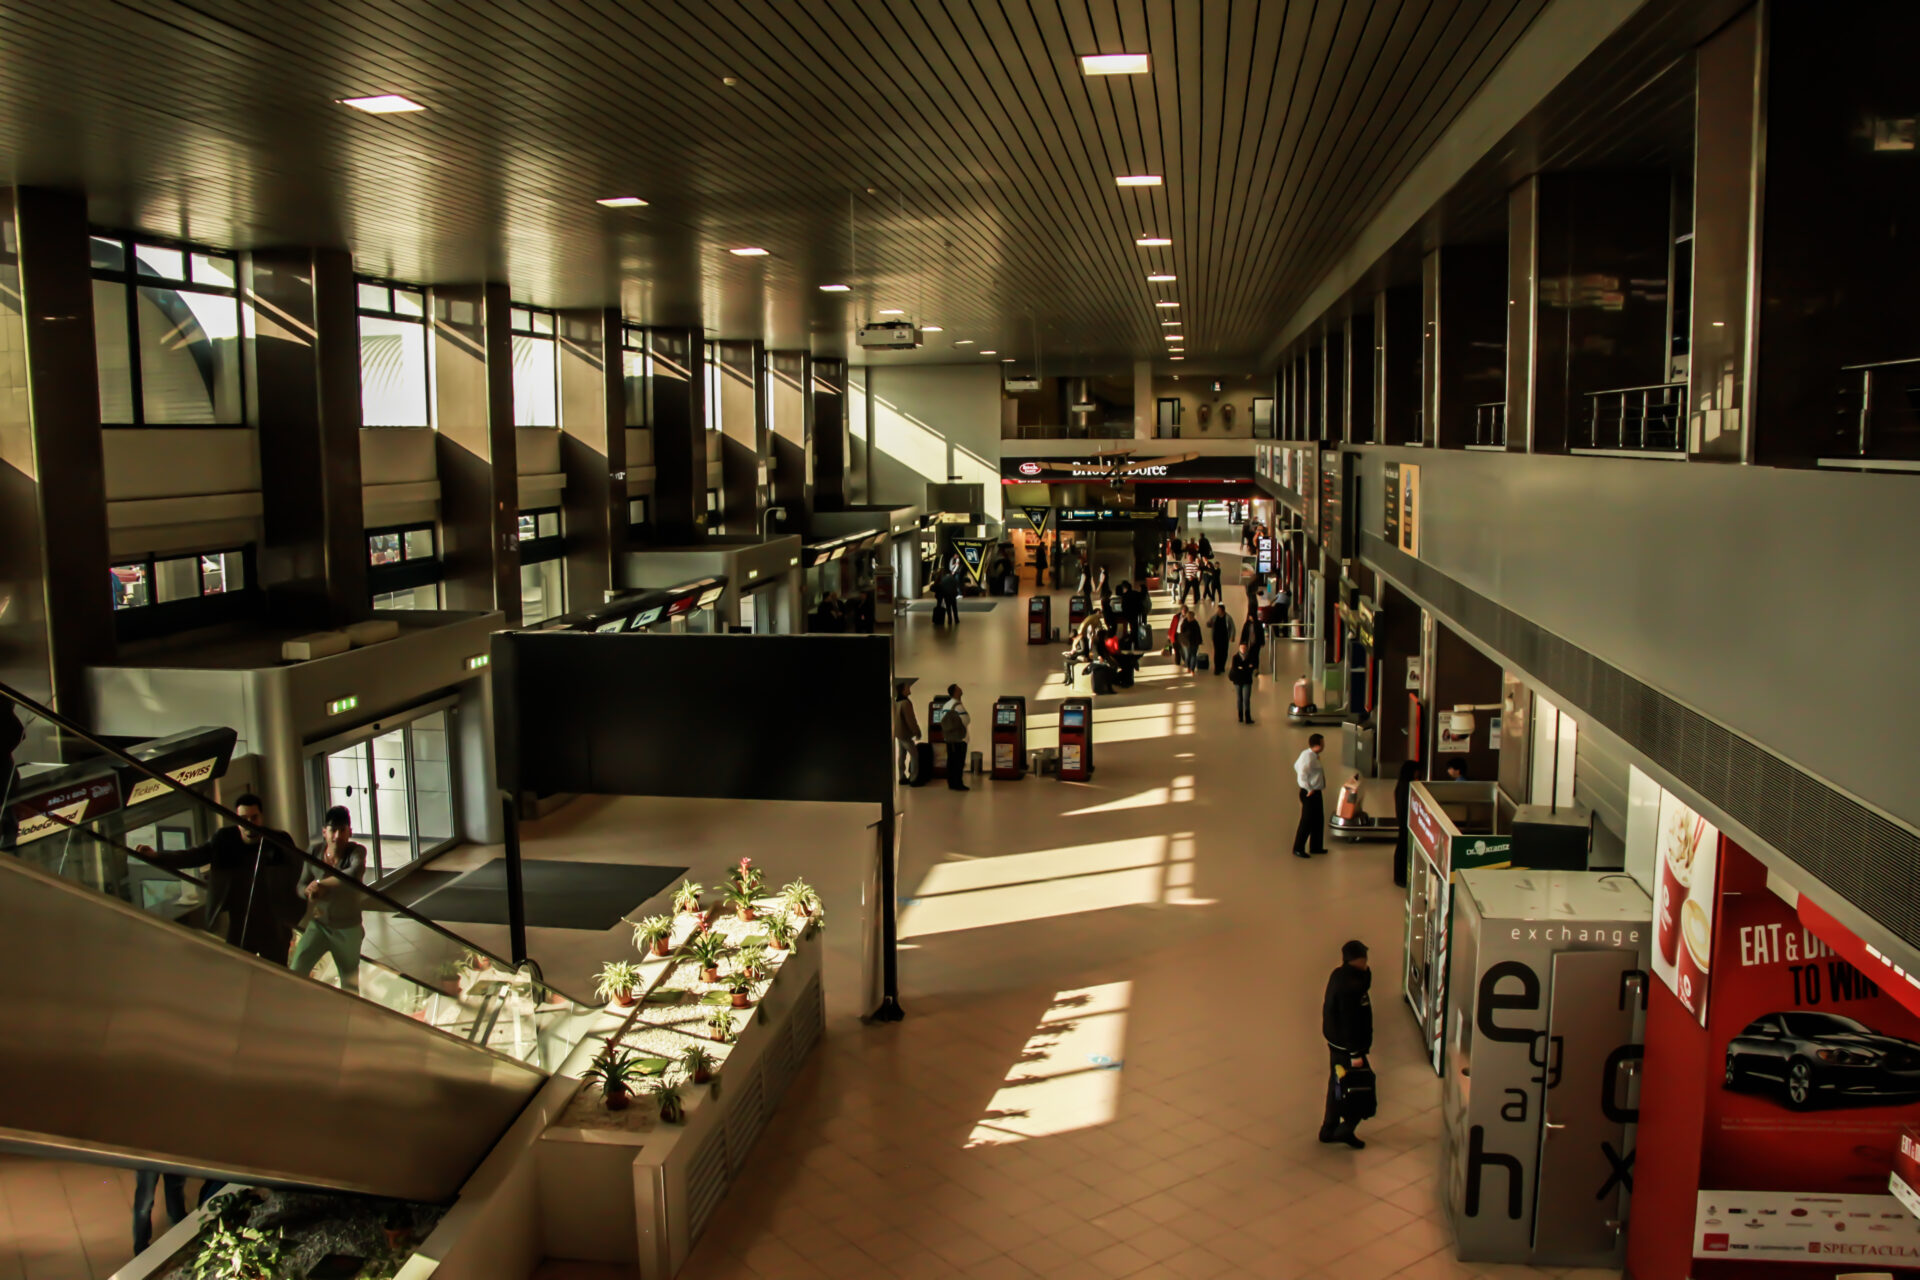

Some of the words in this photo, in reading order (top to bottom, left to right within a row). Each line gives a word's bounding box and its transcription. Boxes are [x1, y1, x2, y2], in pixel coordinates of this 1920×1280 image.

[133, 783, 161, 798] Tickets
[183, 765, 212, 781] SWISS
[1510, 925, 1639, 947] exchange
[1740, 923, 1782, 967] EAT
[1785, 932, 1799, 961] &
[1788, 963, 1821, 1006] TO
